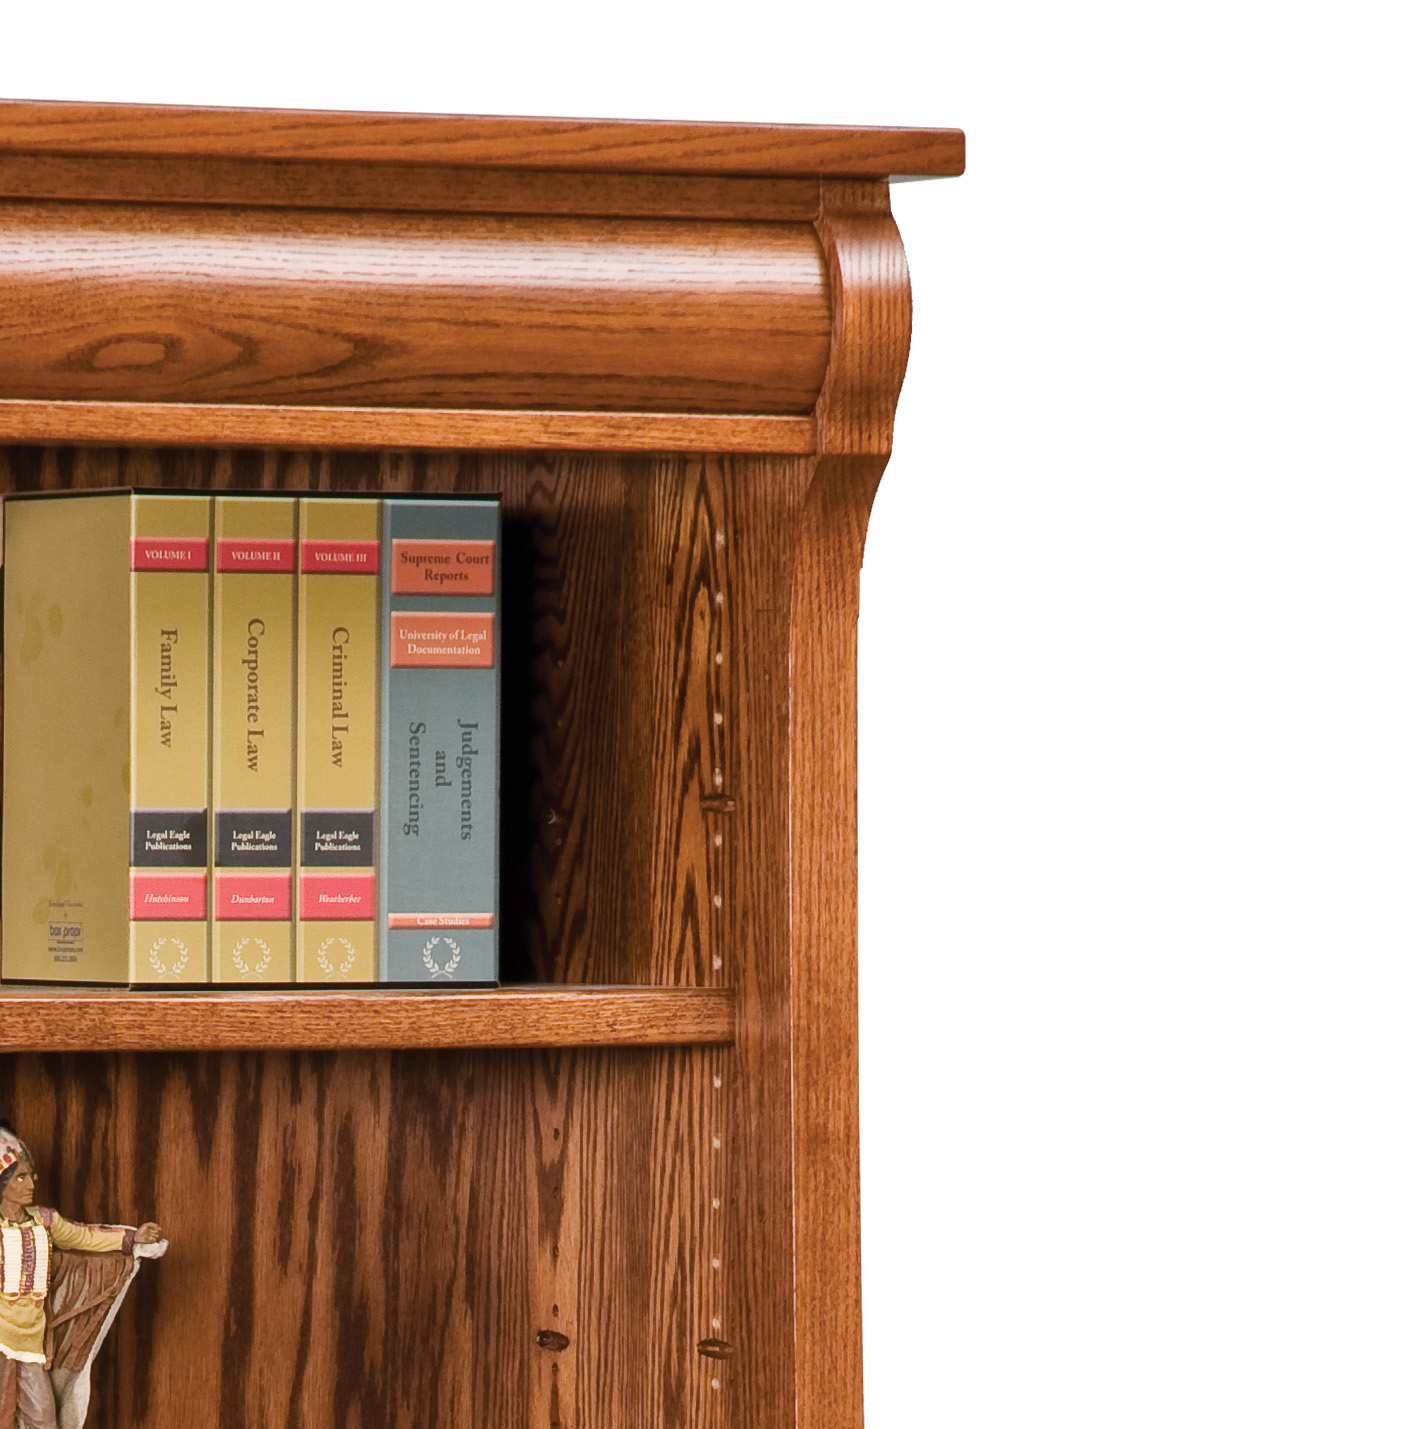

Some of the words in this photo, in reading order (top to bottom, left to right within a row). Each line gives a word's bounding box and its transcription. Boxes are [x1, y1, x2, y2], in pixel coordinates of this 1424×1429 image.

[145, 550, 186, 560] VOLUME
[232, 551, 272, 561] VOLUME
[273, 552, 281, 561] II
[315, 552, 355, 562] VOLUME
[356, 553, 367, 562] III
[400, 551, 450, 567] Supreme
[456, 552, 490, 565] Court
[424, 568, 469, 584] Reports
[399, 629, 447, 643] University
[448, 629, 460, 640] of
[461, 630, 487, 643] Legal
[407, 643, 481, 654] Documentation
[155, 629, 178, 700] Family
[241, 618, 265, 723] Corporate
[332, 626, 350, 720] Criminal
[160, 704, 178, 748] Law
[247, 729, 265, 773] Law
[332, 725, 349, 768] Law
[435, 750, 452, 787] and
[403, 722, 426, 837] Sentencing
[457, 719, 479, 841] Judgements
[147, 830, 168, 841] Legal
[169, 830, 190, 841] Eagle
[233, 830, 254, 841] Legal
[255, 831, 276, 841] Eagle
[316, 830, 337, 841] Legal
[338, 831, 359, 841] Eagle
[145, 841, 192, 851] Publications
[231, 841, 278, 851] Publications
[315, 841, 361, 851] Publications
[417, 916, 437, 926] Case
[438, 916, 470, 926] Studies
